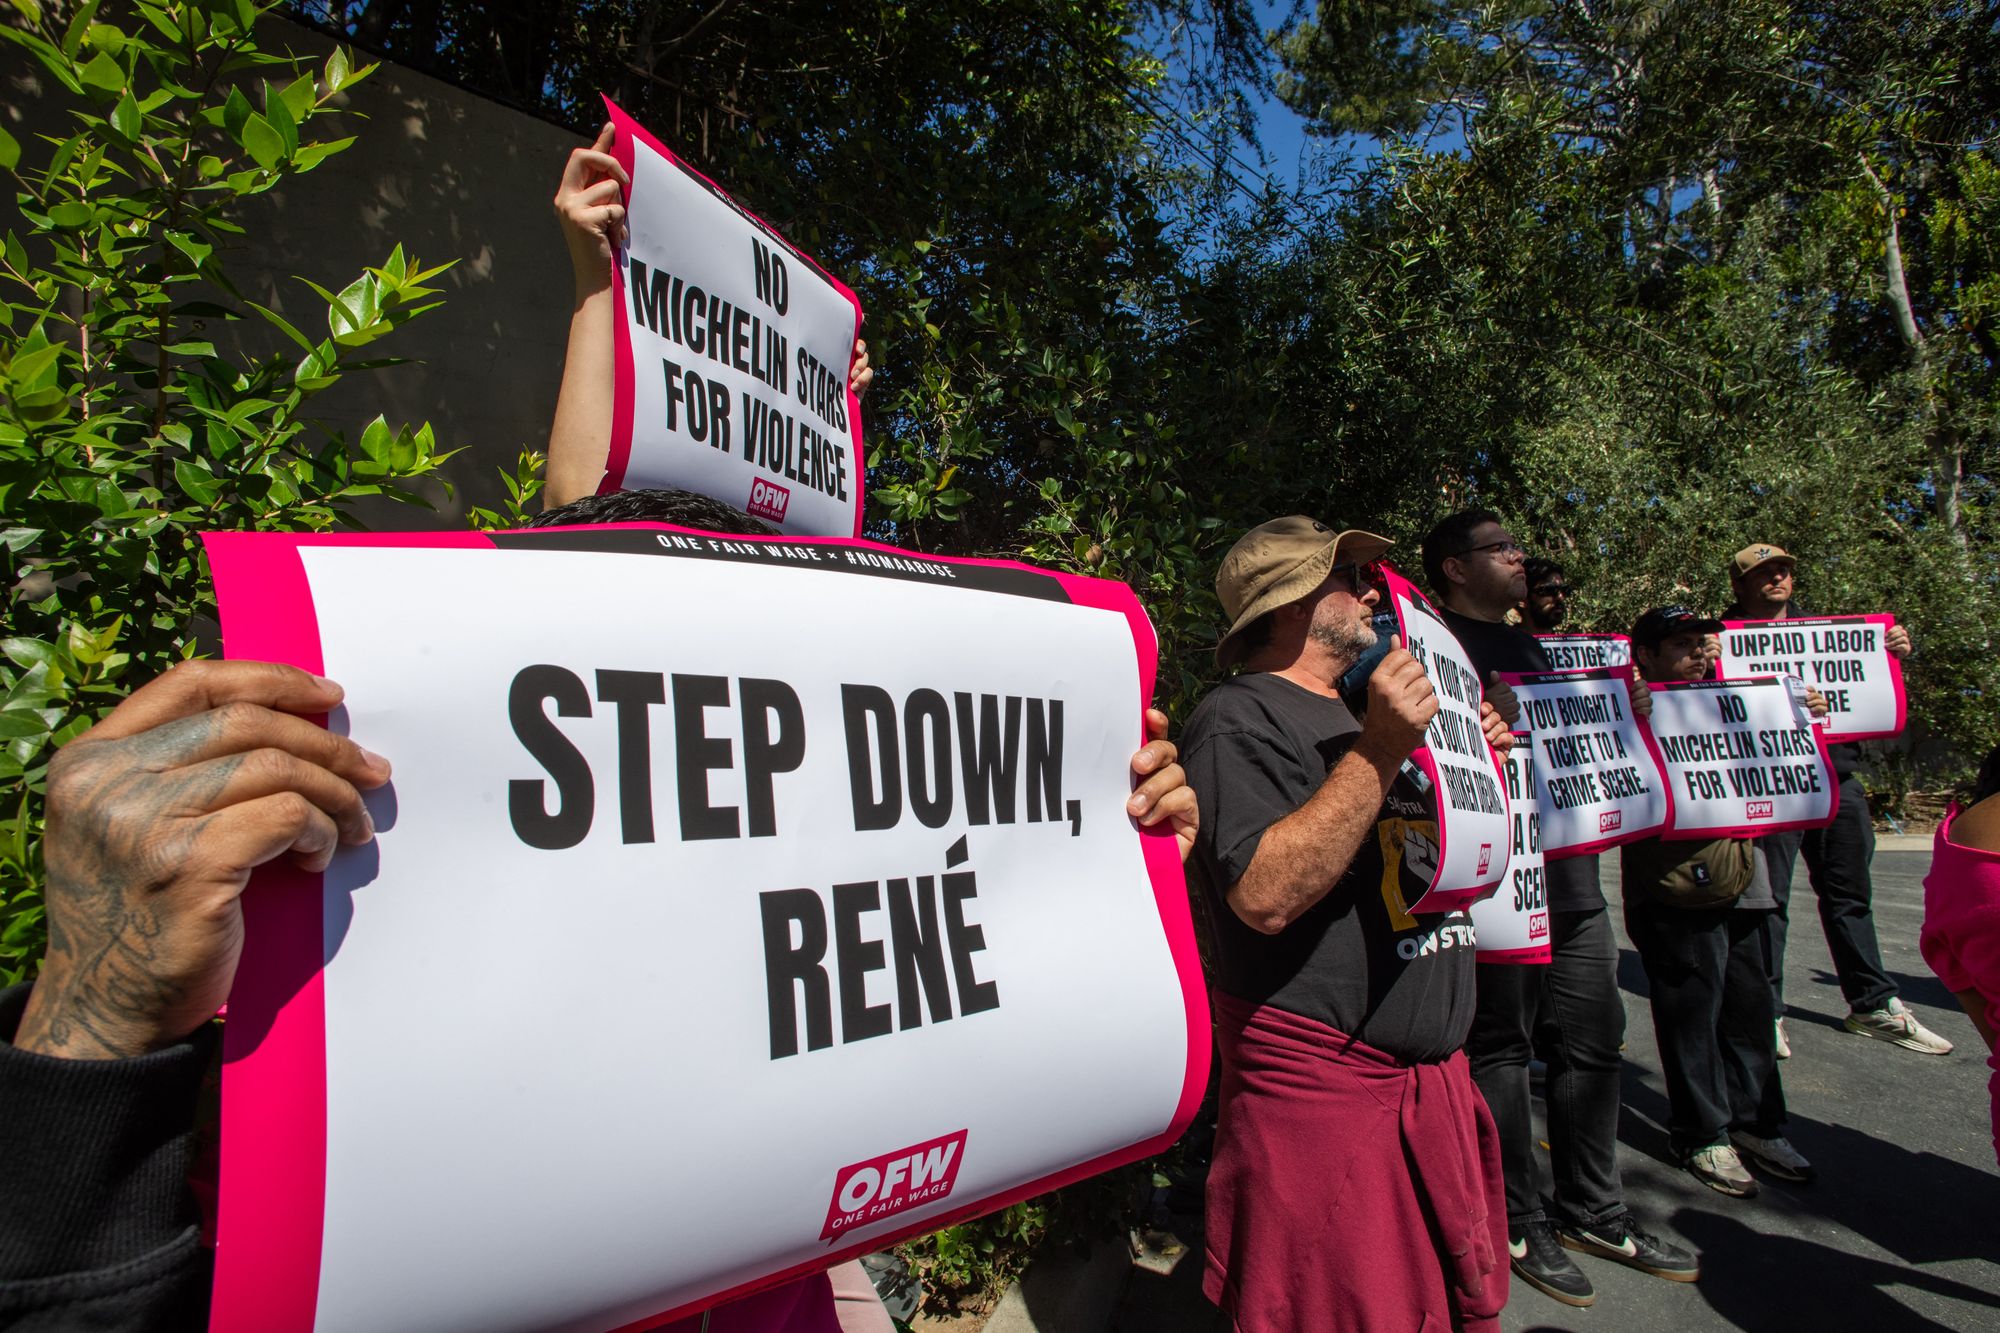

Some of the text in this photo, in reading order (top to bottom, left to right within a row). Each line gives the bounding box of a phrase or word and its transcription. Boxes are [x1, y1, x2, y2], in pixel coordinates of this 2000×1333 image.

[752, 236, 788, 316] NO
[630, 256, 847, 433] MICHELIN STARS
[662, 358, 847, 503] FOR VIOLENCE
[752, 482, 788, 512] OFW
[656, 534, 703, 550] ONE
[710, 540, 760, 557] FAIR
[764, 544, 821, 561] WAGE
[844, 550, 957, 579] #NOMAABUSE
[1544, 644, 1607, 669] RESTIGE
[1730, 629, 1876, 657] UNPAID LABOR
[1433, 651, 1465, 703] YOUR
[1812, 659, 1866, 683] YOUR
[1523, 693, 1624, 731] YOU BOUGHT A
[1716, 694, 1748, 724] NO
[1437, 708, 1468, 756] BUILT
[1542, 730, 1628, 769] TICKET TO A
[1658, 728, 1817, 763] MICHELIN STARS
[508, 663, 1082, 850] STEP DOWN,
[1547, 766, 1651, 810] CRIME SCENE.
[1684, 764, 1822, 800] FOR VIOLENCE
[1600, 812, 1621, 827] OFW
[1747, 802, 1771, 815] OFW
[1512, 812, 1524, 855] A
[759, 833, 1001, 1060] RENÉ
[1397, 931, 1438, 960] ON
[838, 1140, 959, 1213] OFW
[832, 1181, 948, 1229] ONE FAIR WAGE
